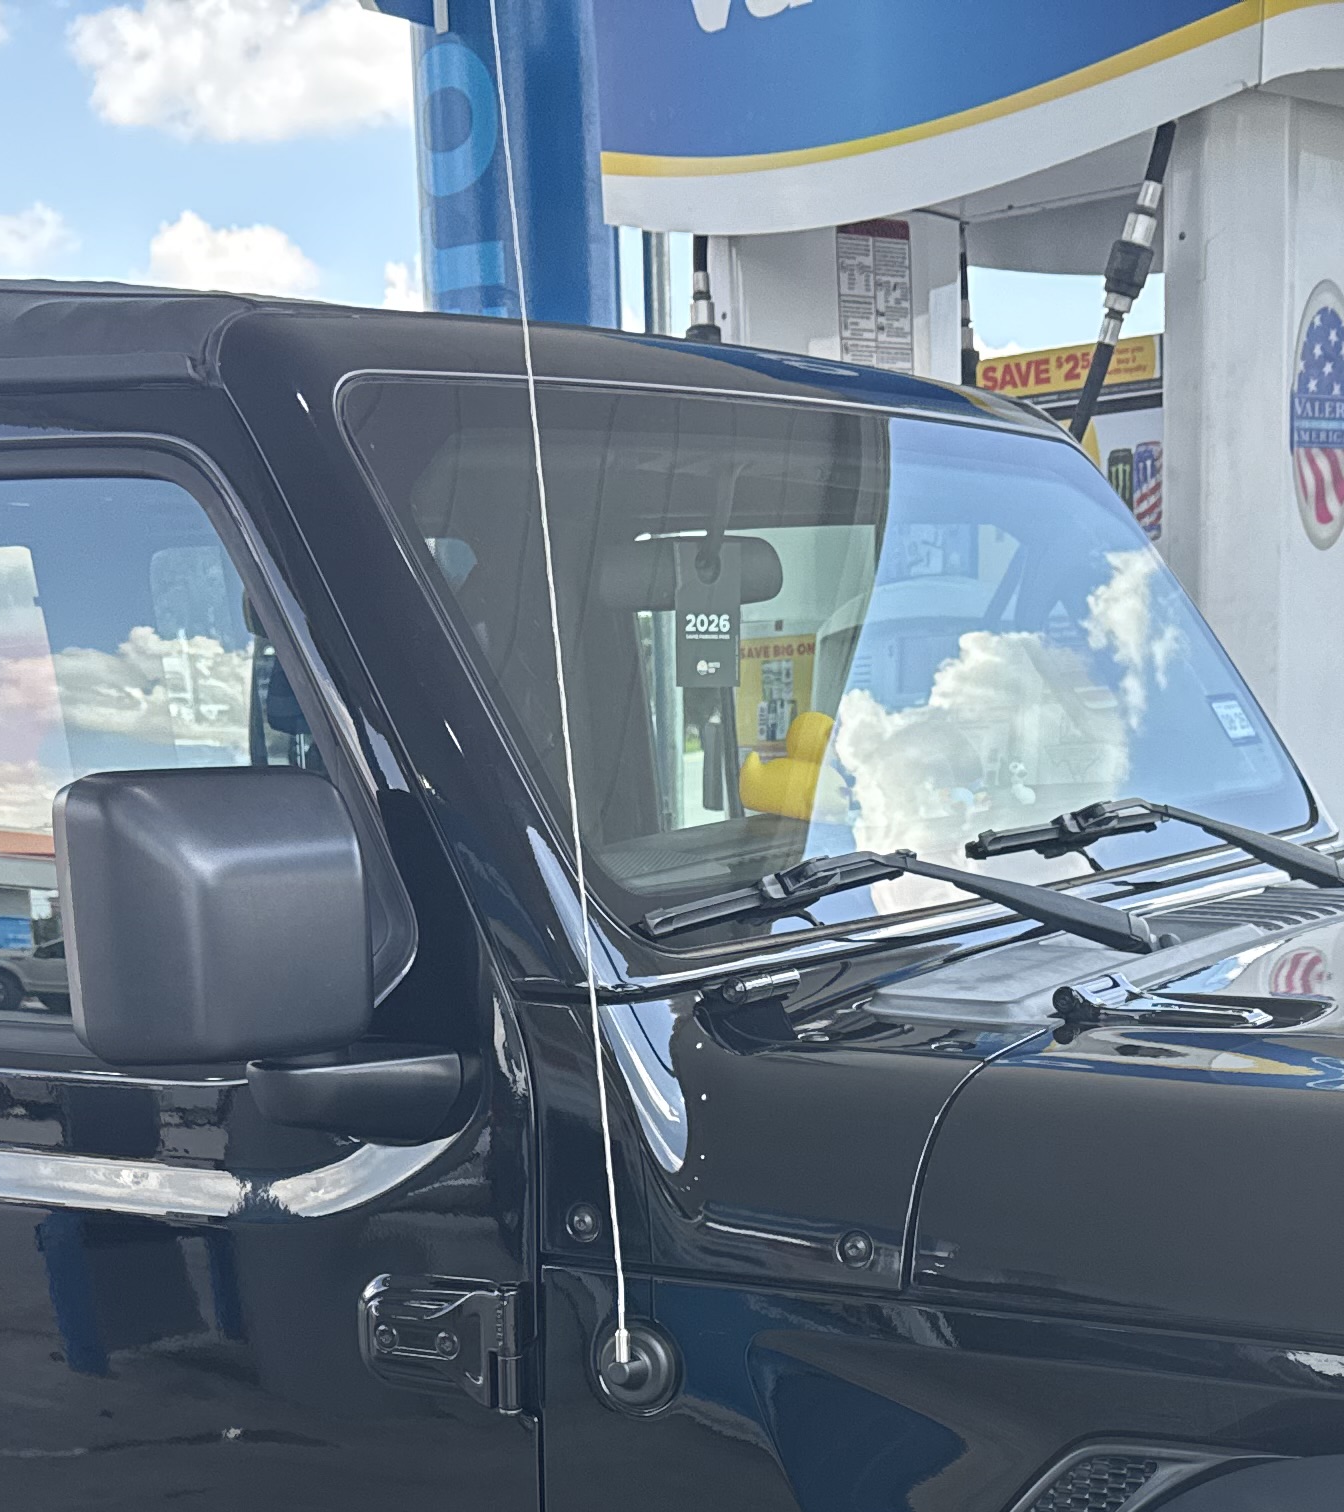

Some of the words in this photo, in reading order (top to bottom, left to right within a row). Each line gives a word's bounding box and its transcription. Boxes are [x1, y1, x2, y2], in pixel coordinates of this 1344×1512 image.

[982, 358, 1052, 392] SAVE
[685, 613, 731, 633] 2026
[740, 645, 770, 660] SAVE
[772, 643, 794, 658] BIG
